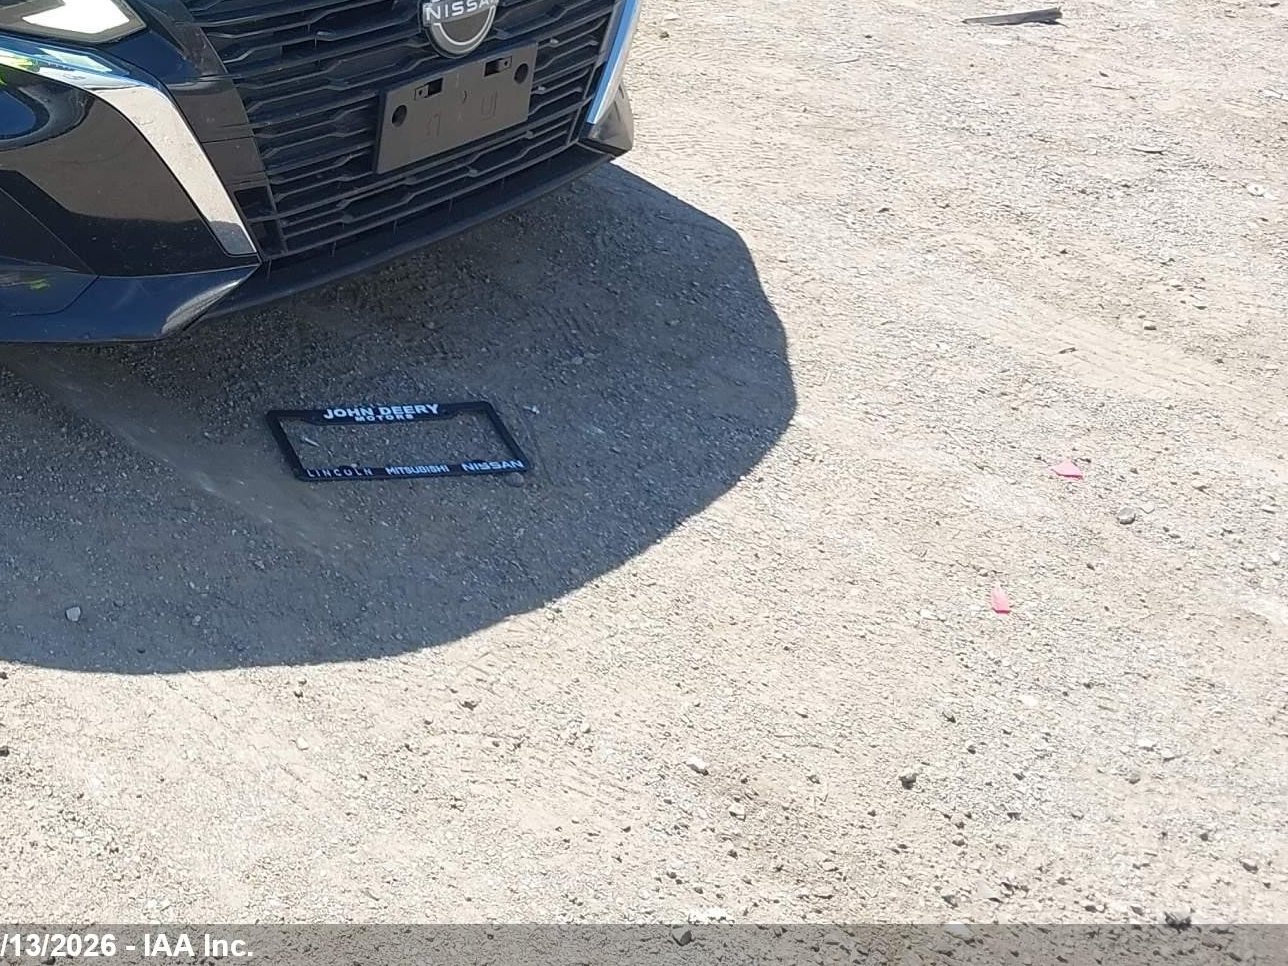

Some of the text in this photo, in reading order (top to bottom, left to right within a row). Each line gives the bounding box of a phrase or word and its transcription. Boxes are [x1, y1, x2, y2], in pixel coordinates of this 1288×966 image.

[323, 404, 439, 420] JOHN DEERY
[354, 414, 414, 422] MOTORS
[306, 460, 525, 478] LINCOLN MITSUBISHI NISSAN
